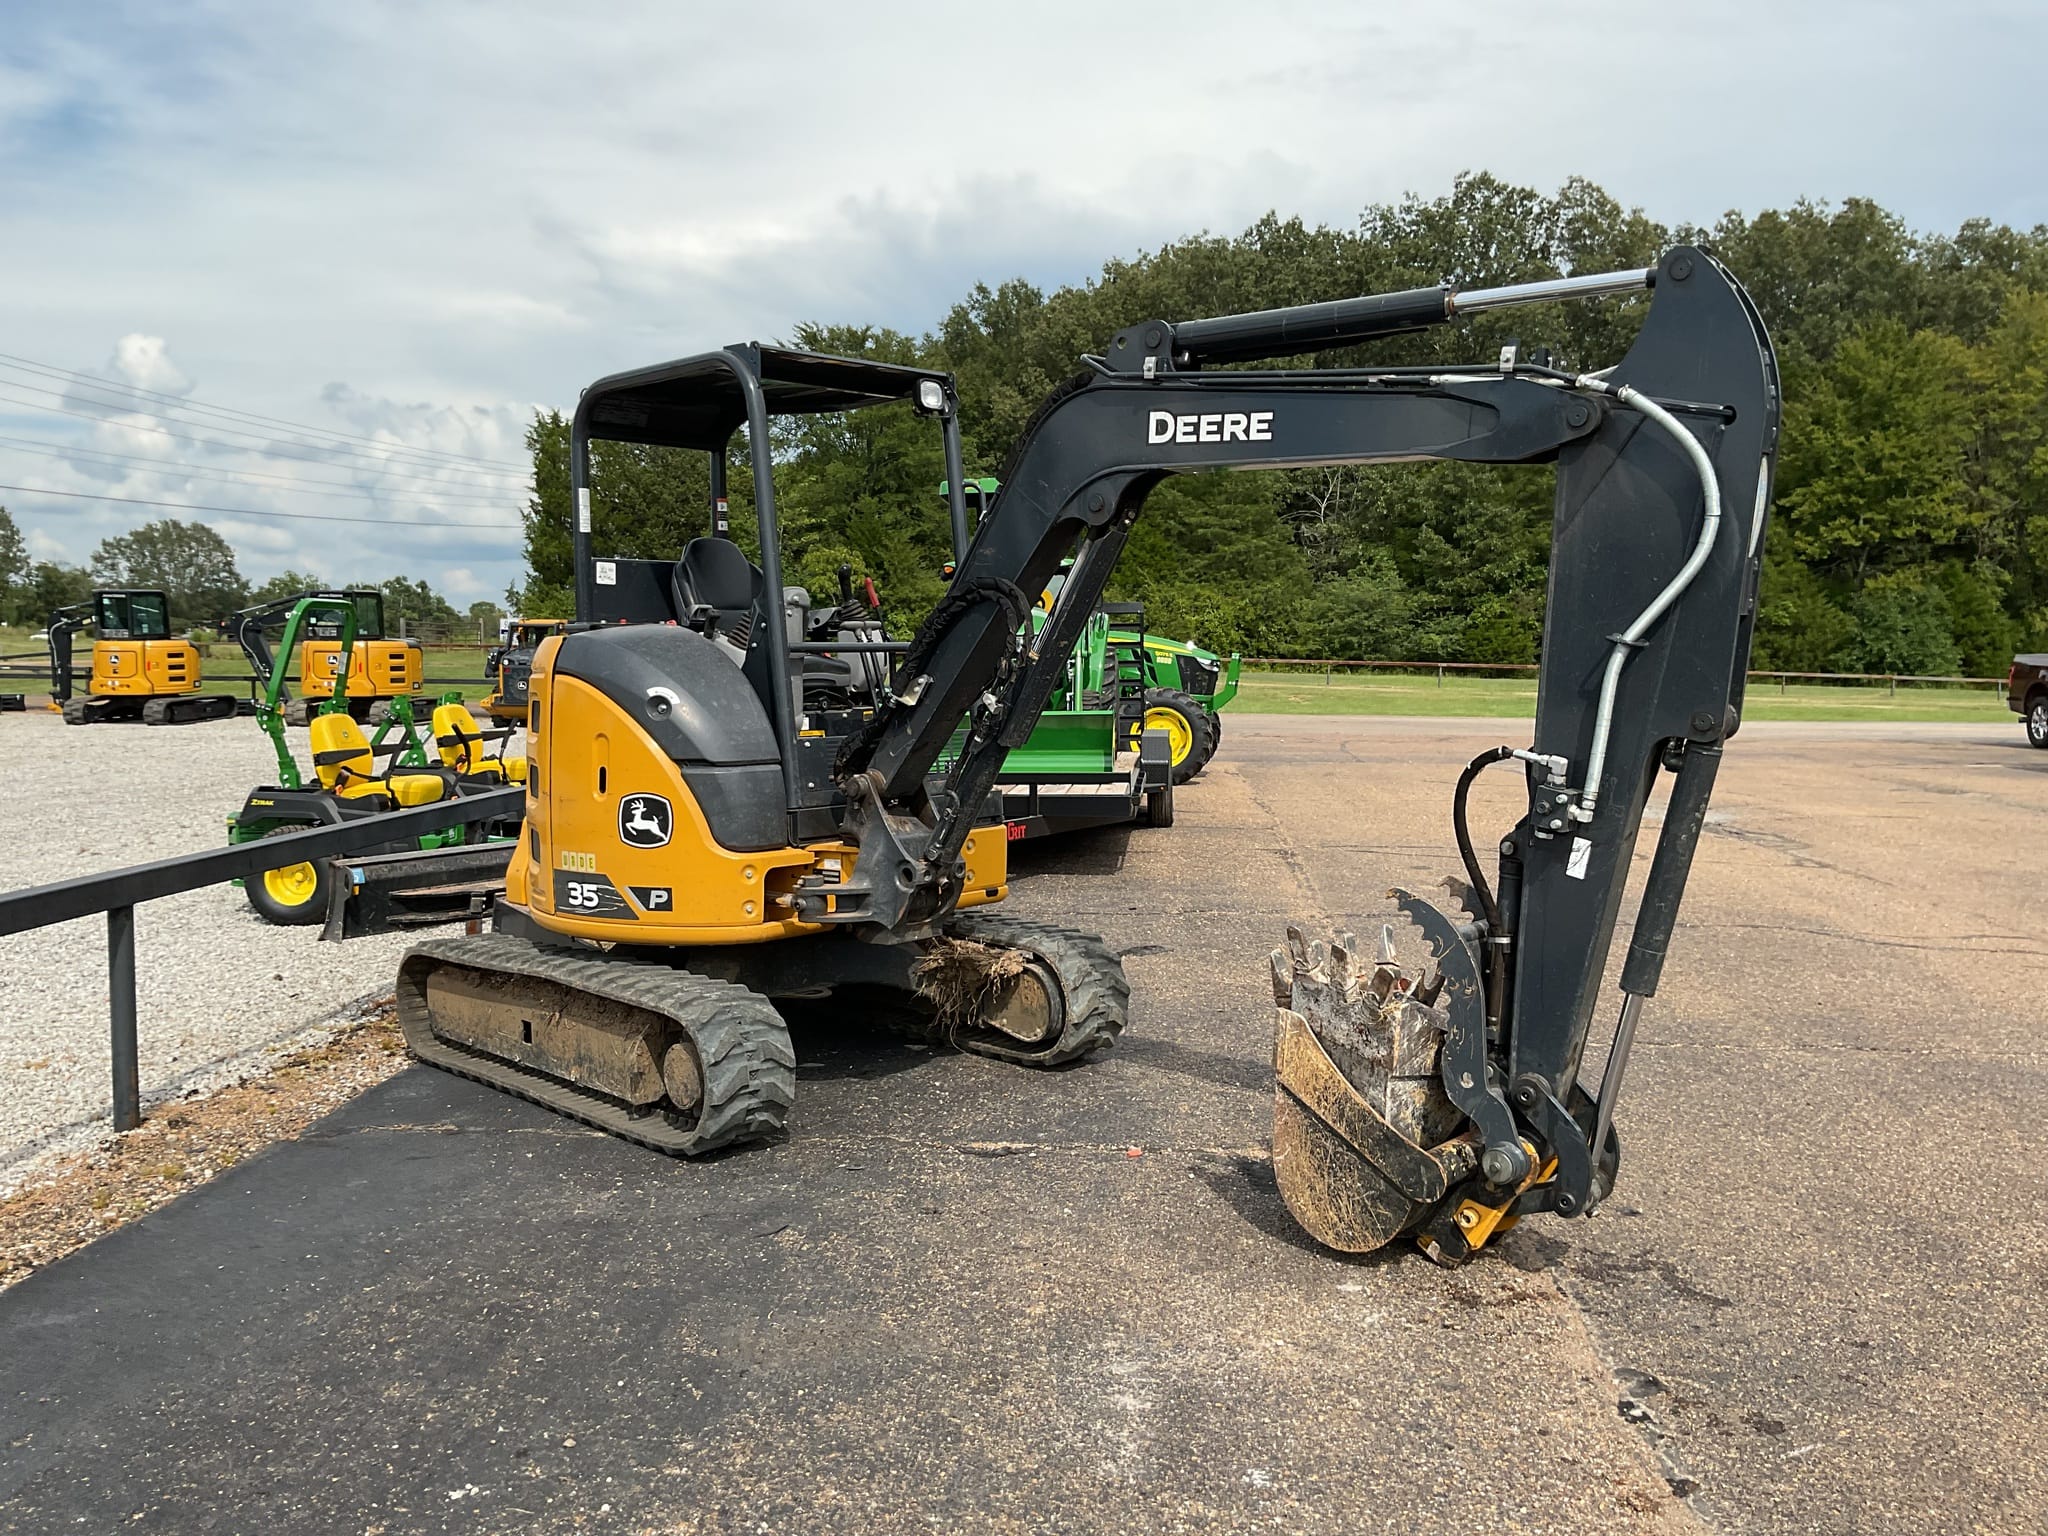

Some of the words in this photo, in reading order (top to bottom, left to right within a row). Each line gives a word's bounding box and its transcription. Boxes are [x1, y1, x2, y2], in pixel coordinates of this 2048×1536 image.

[1148, 411, 1274, 444] DEERE
[1007, 822, 1026, 841] GRIT
[567, 882, 599, 908] 35
[649, 890, 668, 909] P
